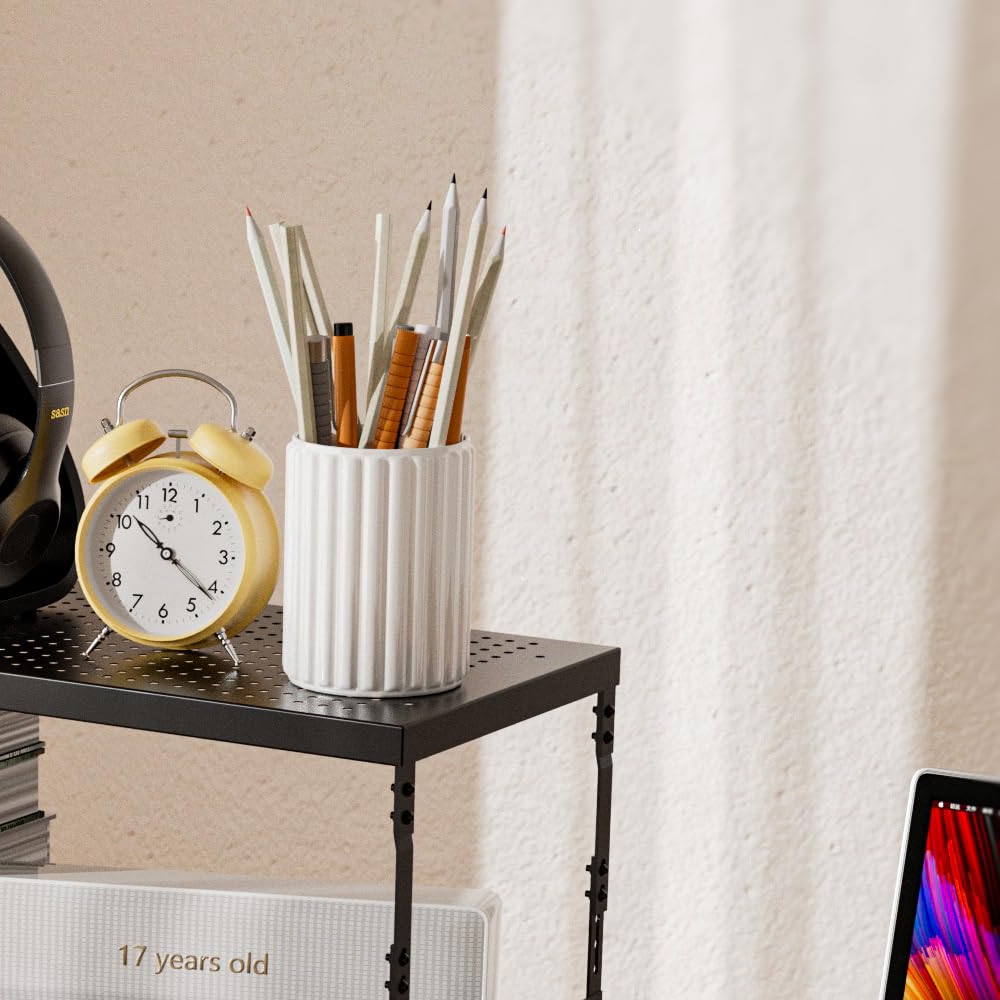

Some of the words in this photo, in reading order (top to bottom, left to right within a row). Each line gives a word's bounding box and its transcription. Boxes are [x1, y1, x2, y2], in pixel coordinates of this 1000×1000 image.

[138, 495, 149, 509] 11
[162, 488, 178, 503] 12
[194, 498, 199, 513] 1
[116, 514, 132, 529] 10
[212, 521, 221, 535] 2
[106, 543, 115, 558] 9
[219, 550, 228, 564] 3
[112, 572, 121, 586] 8
[208, 580, 218, 593] 4
[133, 594, 143, 608] 7
[186, 598, 196, 612] 5
[159, 604, 168, 618] 6
[119, 944, 147, 967] 17
[155, 952, 221, 975] years
[229, 952, 269, 975] old
